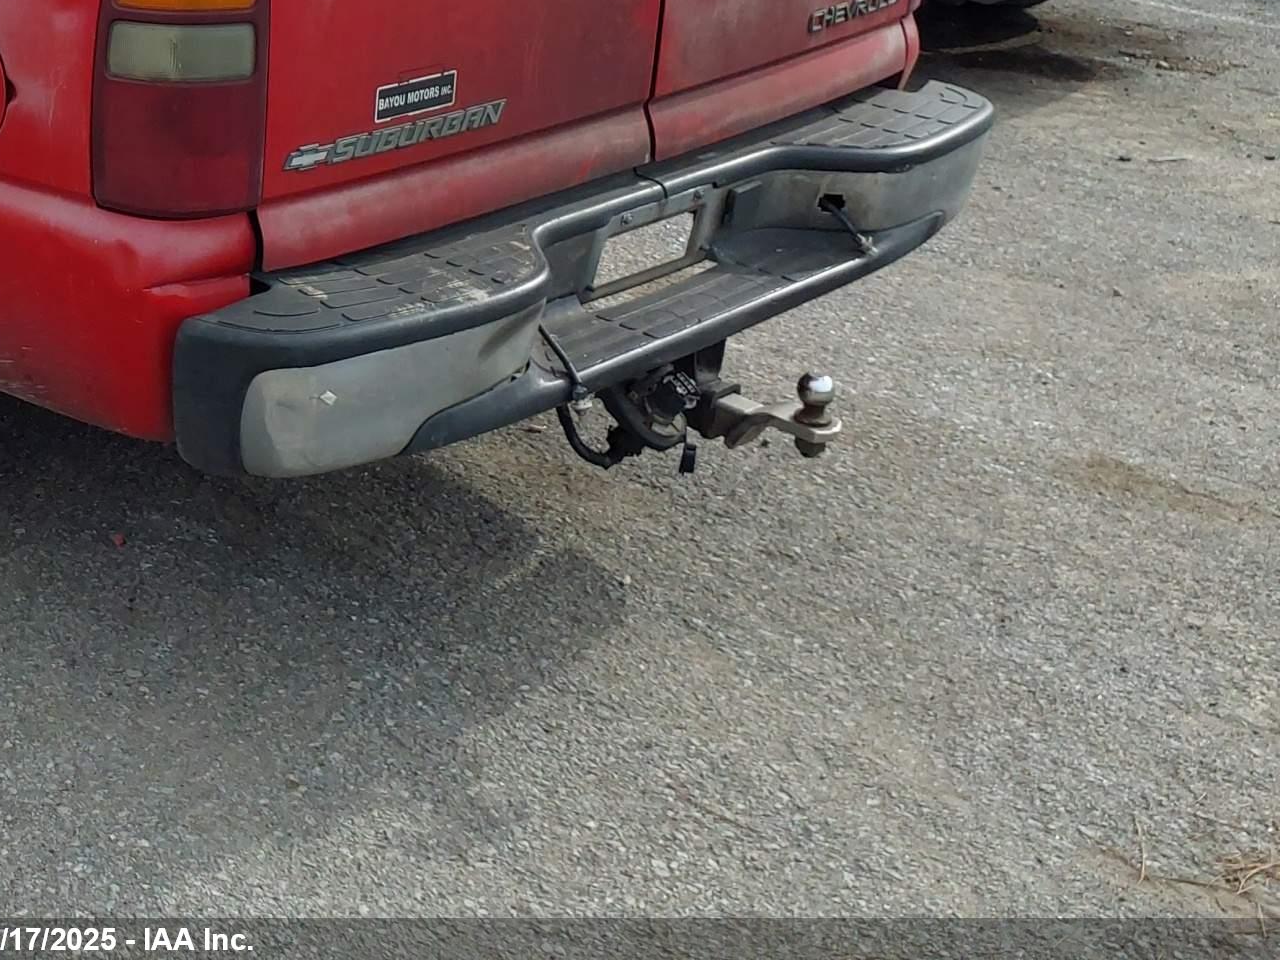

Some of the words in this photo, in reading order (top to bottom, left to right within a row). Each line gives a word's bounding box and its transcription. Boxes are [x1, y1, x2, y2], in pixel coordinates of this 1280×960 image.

[378, 93, 406, 111] BAYOU
[406, 86, 439, 104] MOTORS
[333, 100, 506, 162] SUBURBAN
